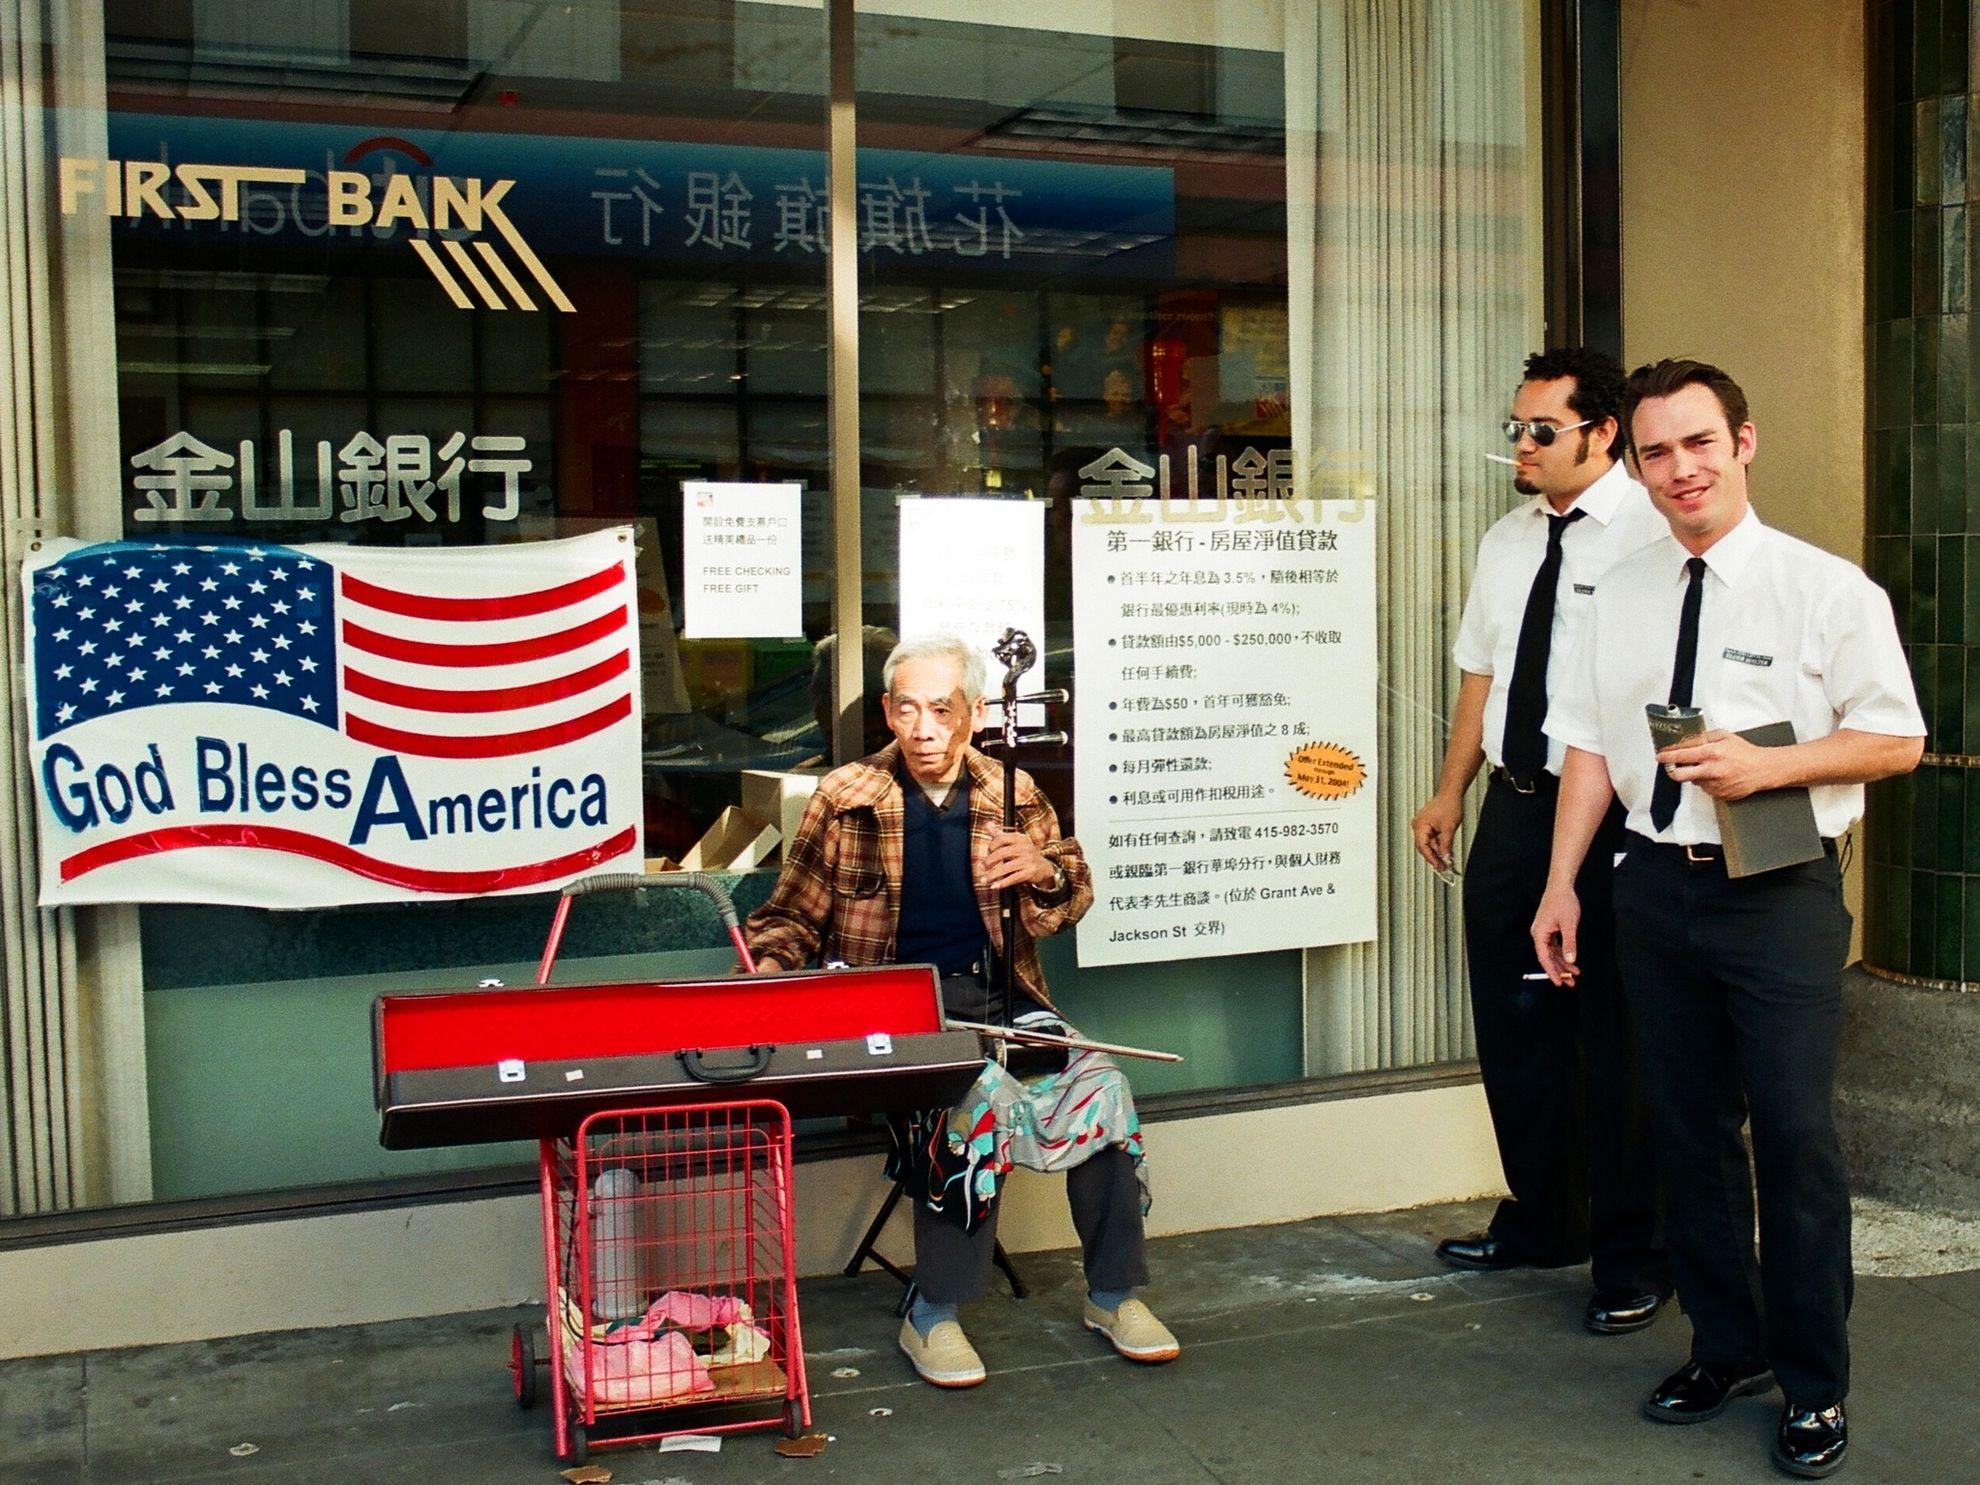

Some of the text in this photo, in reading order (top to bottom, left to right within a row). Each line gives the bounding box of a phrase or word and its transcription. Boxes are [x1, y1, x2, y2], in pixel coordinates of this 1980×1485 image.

[59, 157, 305, 222] FIRST
[131, 429, 532, 523] 金山銀行
[1078, 444, 1370, 524] 金山銀行
[1107, 530, 1193, 552] 第一銀行
[1210, 529, 1339, 552] 房屋淨值貸款
[703, 566, 791, 576] FREE CHECKING
[703, 584, 759, 593] FREE GIFT
[1317, 758, 1354, 771] Extended
[1297, 773, 1314, 783] May
[42, 736, 608, 846] God Bless America
[1255, 822, 1339, 838] 415-982-3570
[1260, 887, 1297, 900] Grant
[1300, 885, 1323, 897] Ave
[1327, 882, 1336, 895] &
[1109, 929, 1168, 942] Jackson
[1172, 926, 1187, 938] St
